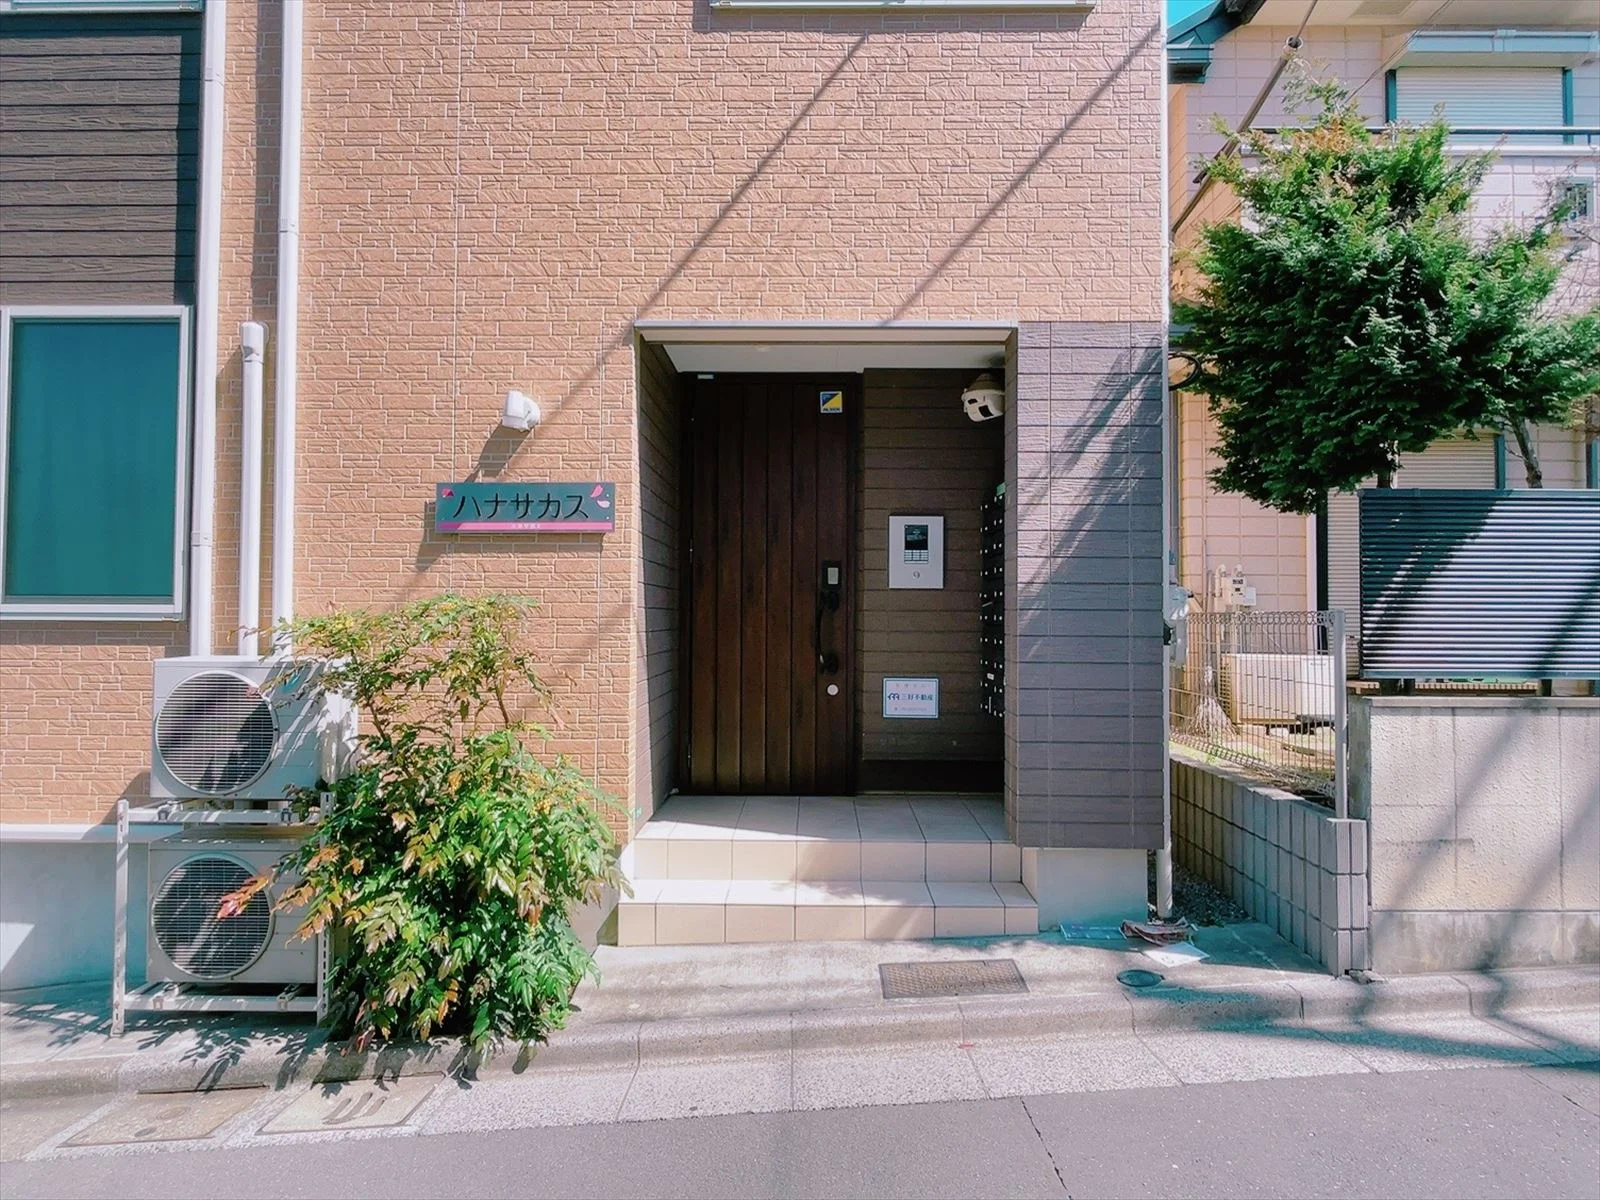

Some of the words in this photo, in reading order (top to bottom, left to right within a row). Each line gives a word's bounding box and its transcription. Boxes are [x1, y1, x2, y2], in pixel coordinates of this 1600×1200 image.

[453, 492, 589, 519] ハナサカス
